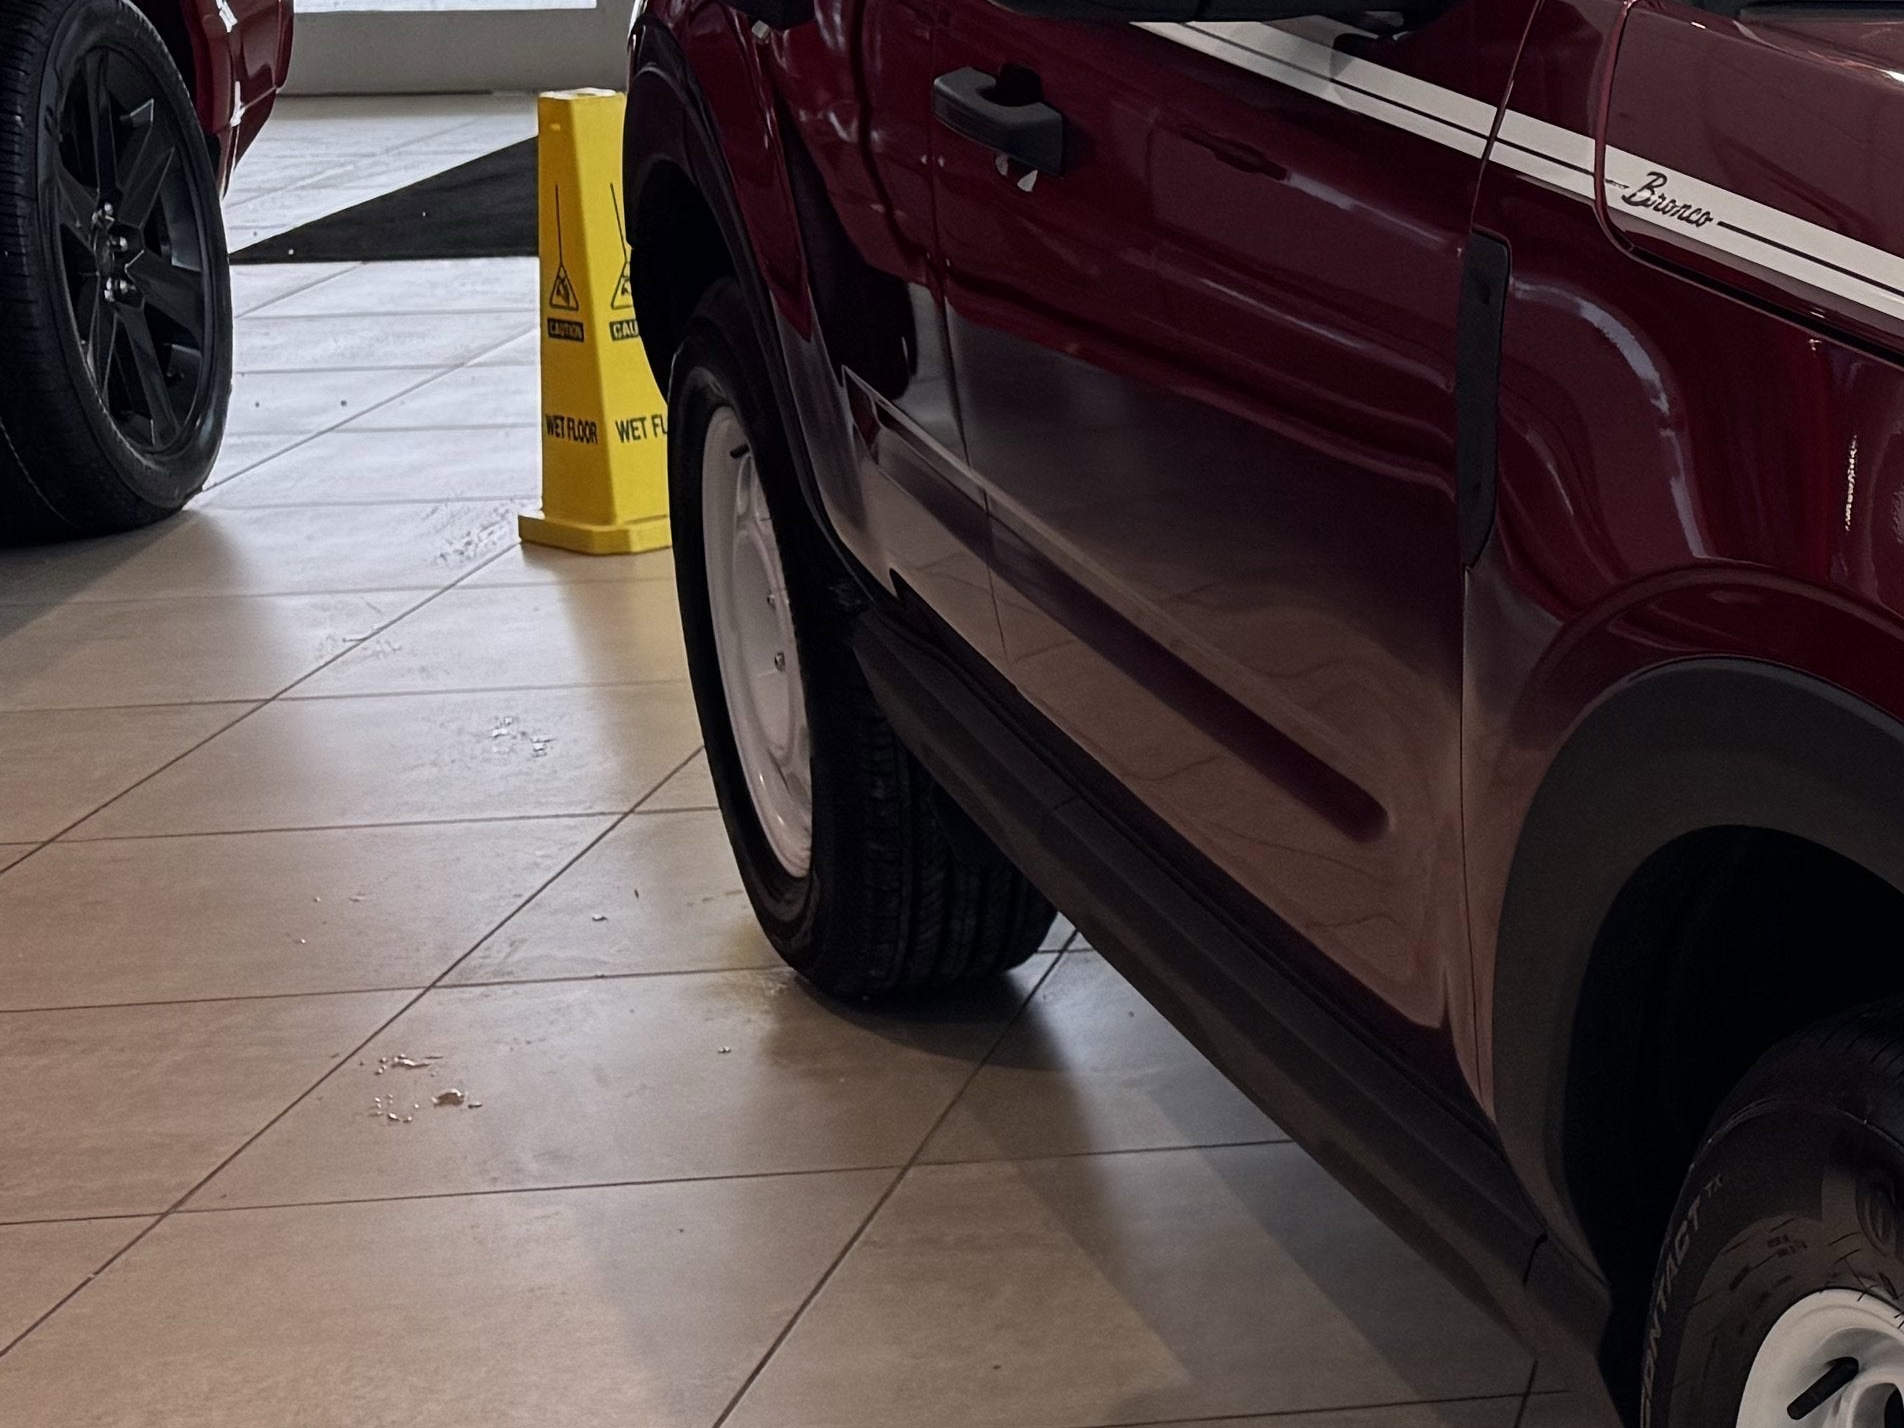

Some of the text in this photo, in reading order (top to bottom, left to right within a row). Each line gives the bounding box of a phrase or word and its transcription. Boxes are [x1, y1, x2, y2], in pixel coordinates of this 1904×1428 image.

[1621, 171, 1713, 227] Bronco
[545, 414, 598, 444] WET FLOOR
[615, 416, 648, 443] WET
